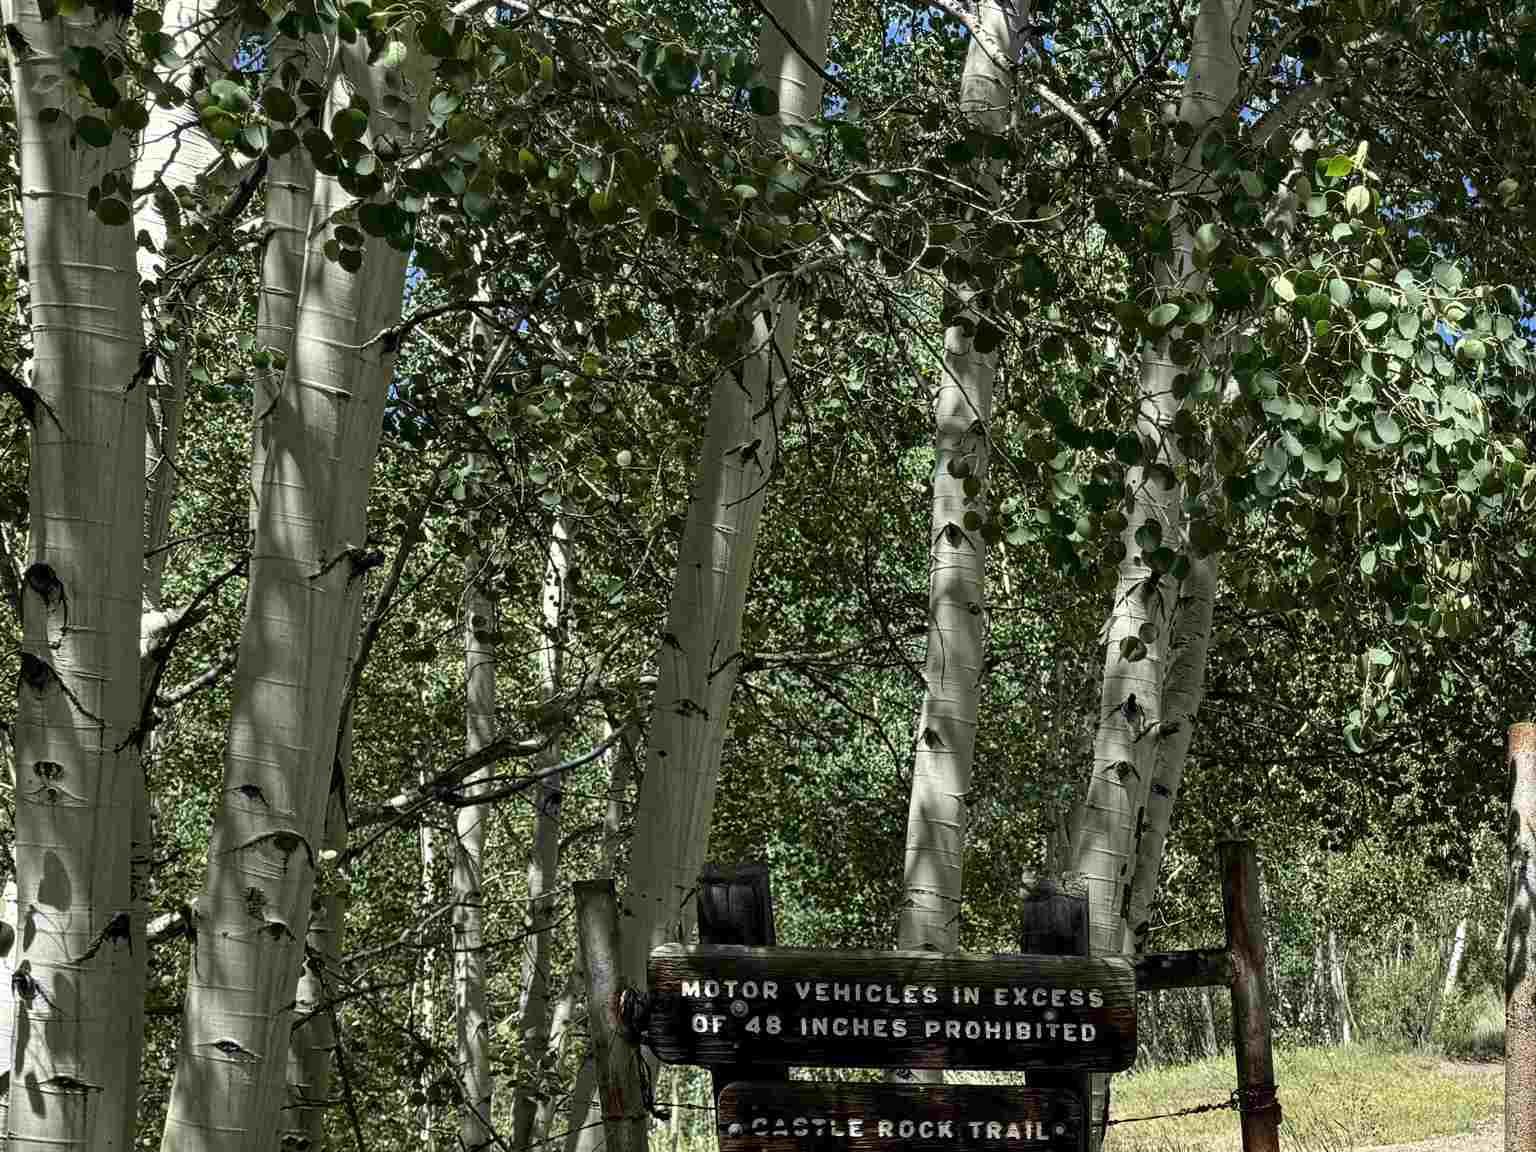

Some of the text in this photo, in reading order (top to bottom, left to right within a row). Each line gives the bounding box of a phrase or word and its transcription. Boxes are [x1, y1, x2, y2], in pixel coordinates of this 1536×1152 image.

[681, 980, 1104, 1008] MOTOR VEHICLES IN EXCESS
[691, 1014, 1096, 1042] OF 48 INCHES PROHIBITED
[752, 1117, 1050, 1141] CASTLE ROCK TRAIL
